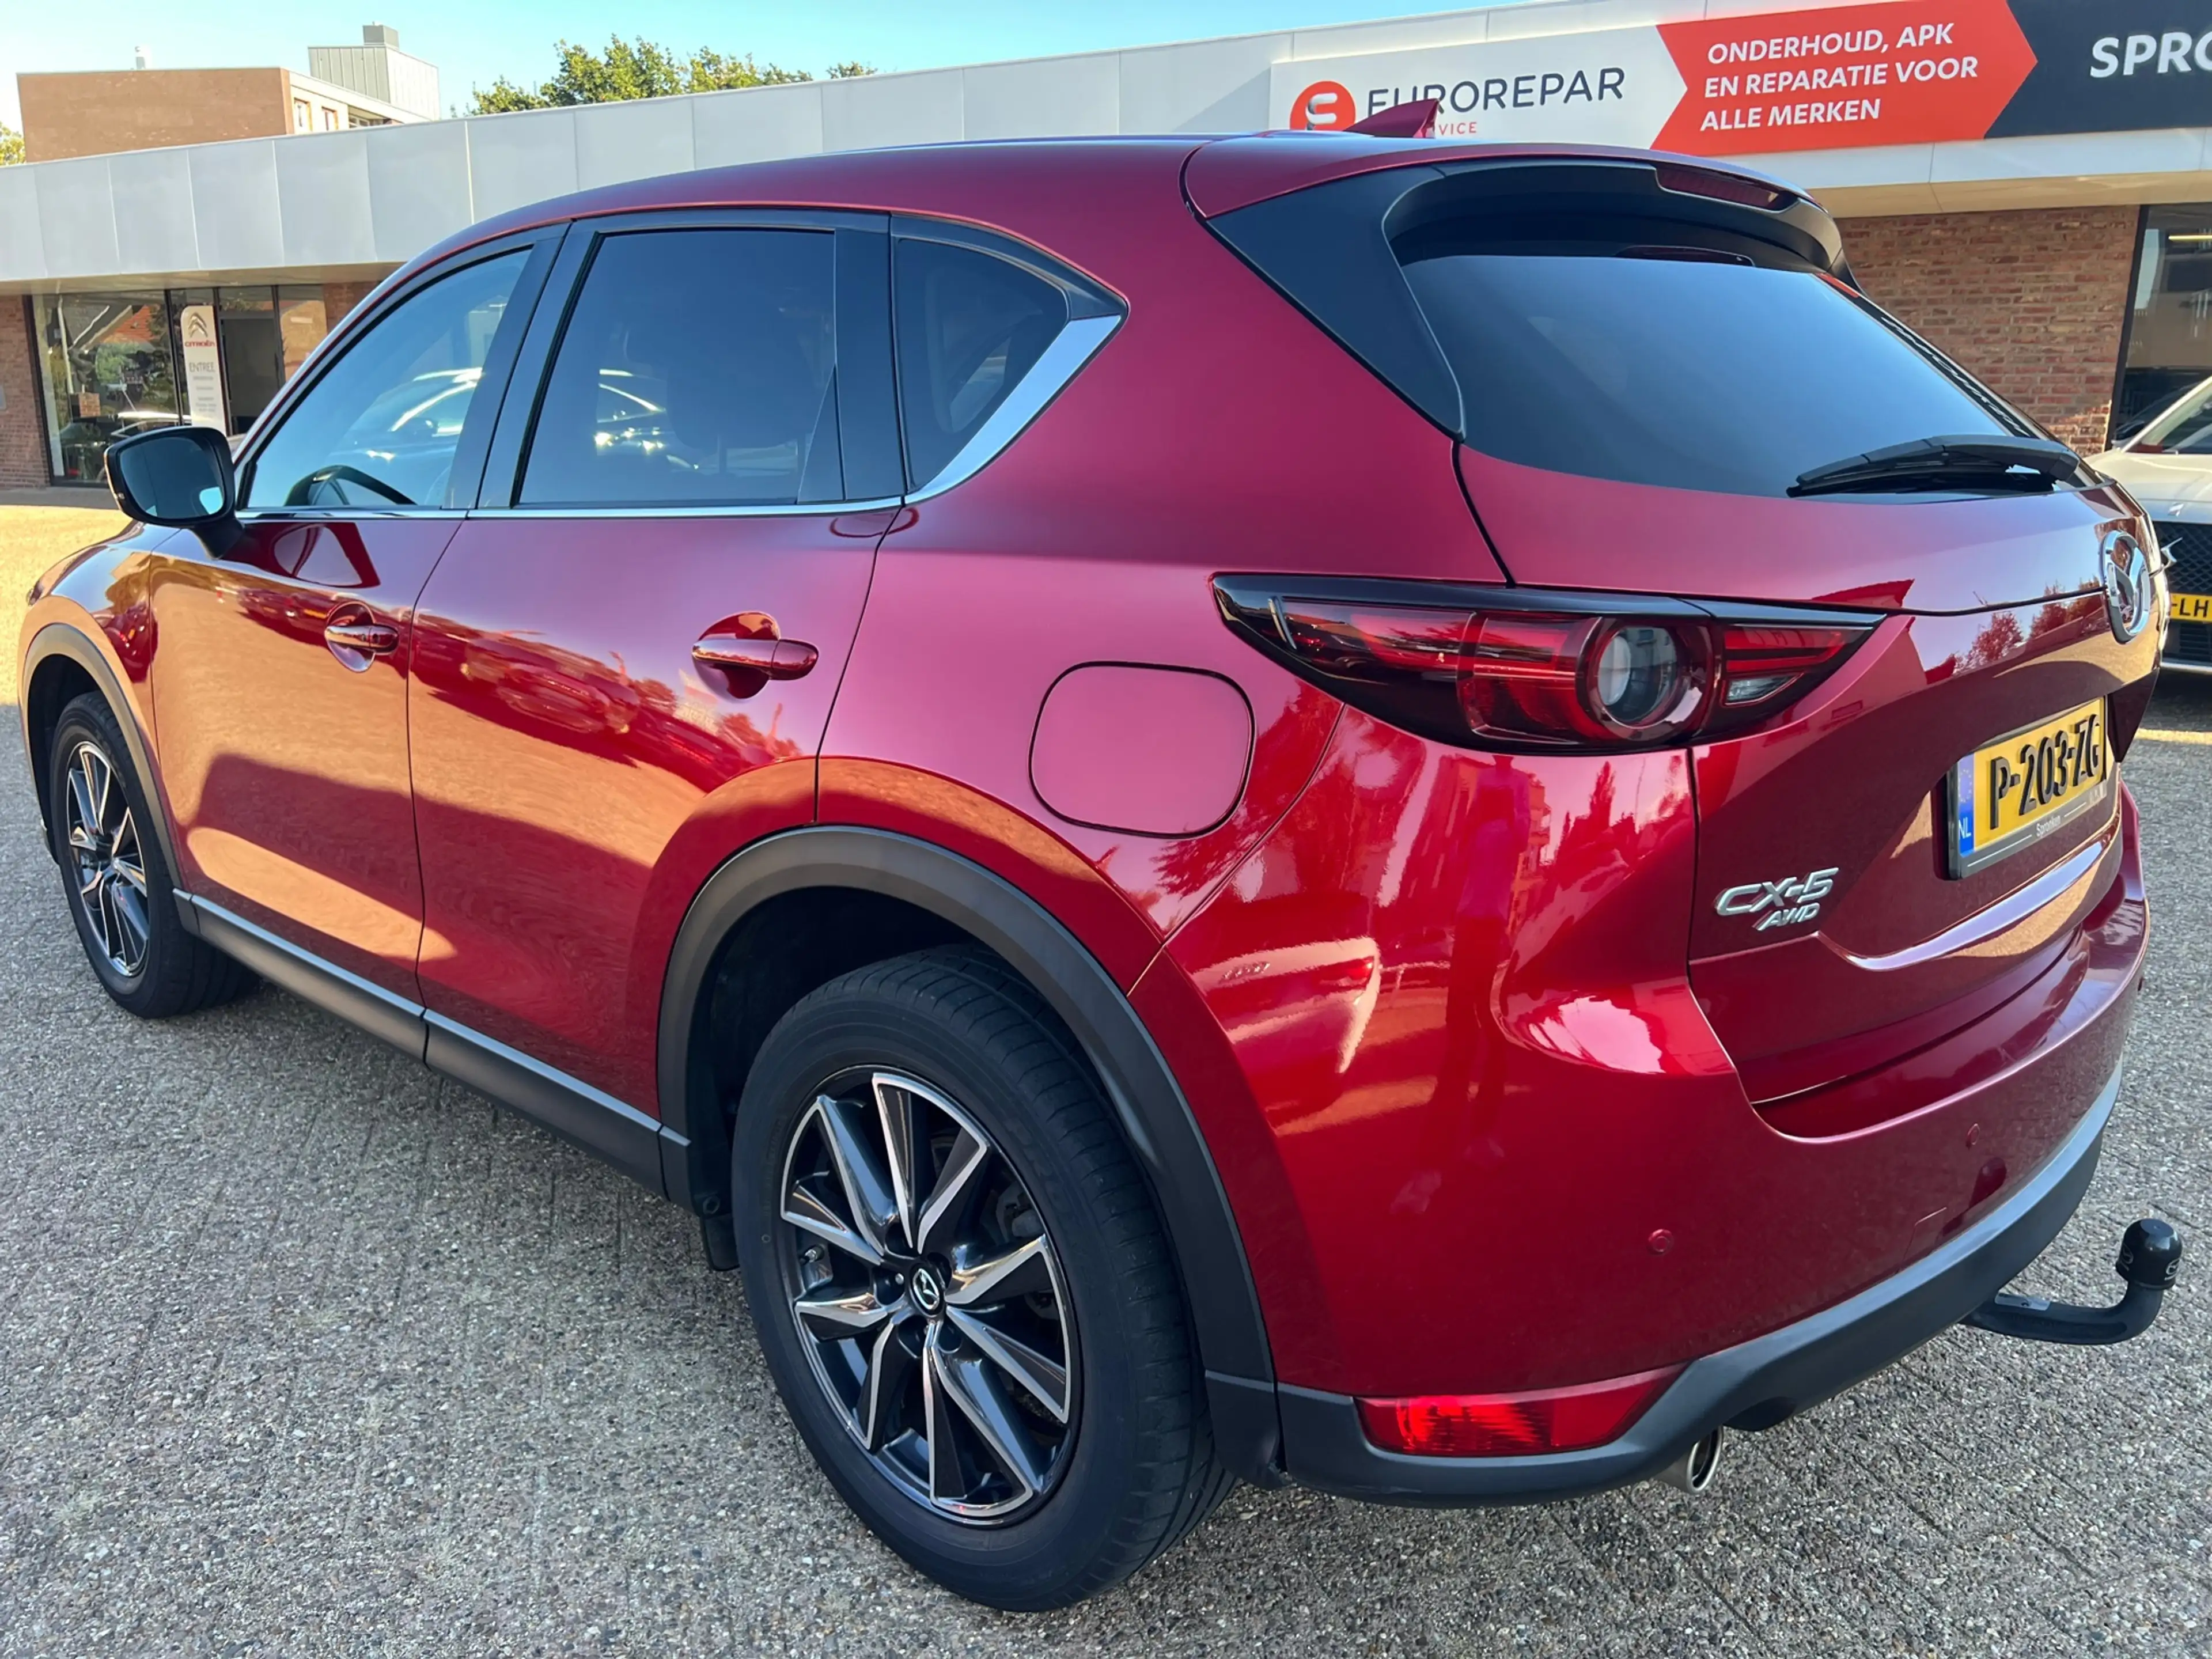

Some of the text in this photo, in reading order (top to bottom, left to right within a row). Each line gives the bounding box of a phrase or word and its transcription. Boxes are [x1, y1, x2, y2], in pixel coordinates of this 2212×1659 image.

[1707, 22, 1955, 65] ONDERHOUD, APK
[1705, 56, 1978, 98] EN REPARATIE VOOR
[1699, 99, 1881, 132] ALLE MERKEN
[1959, 817, 1971, 840] NL
[1715, 867, 1839, 916] CX-5
[1756, 902, 1820, 931] AWD
